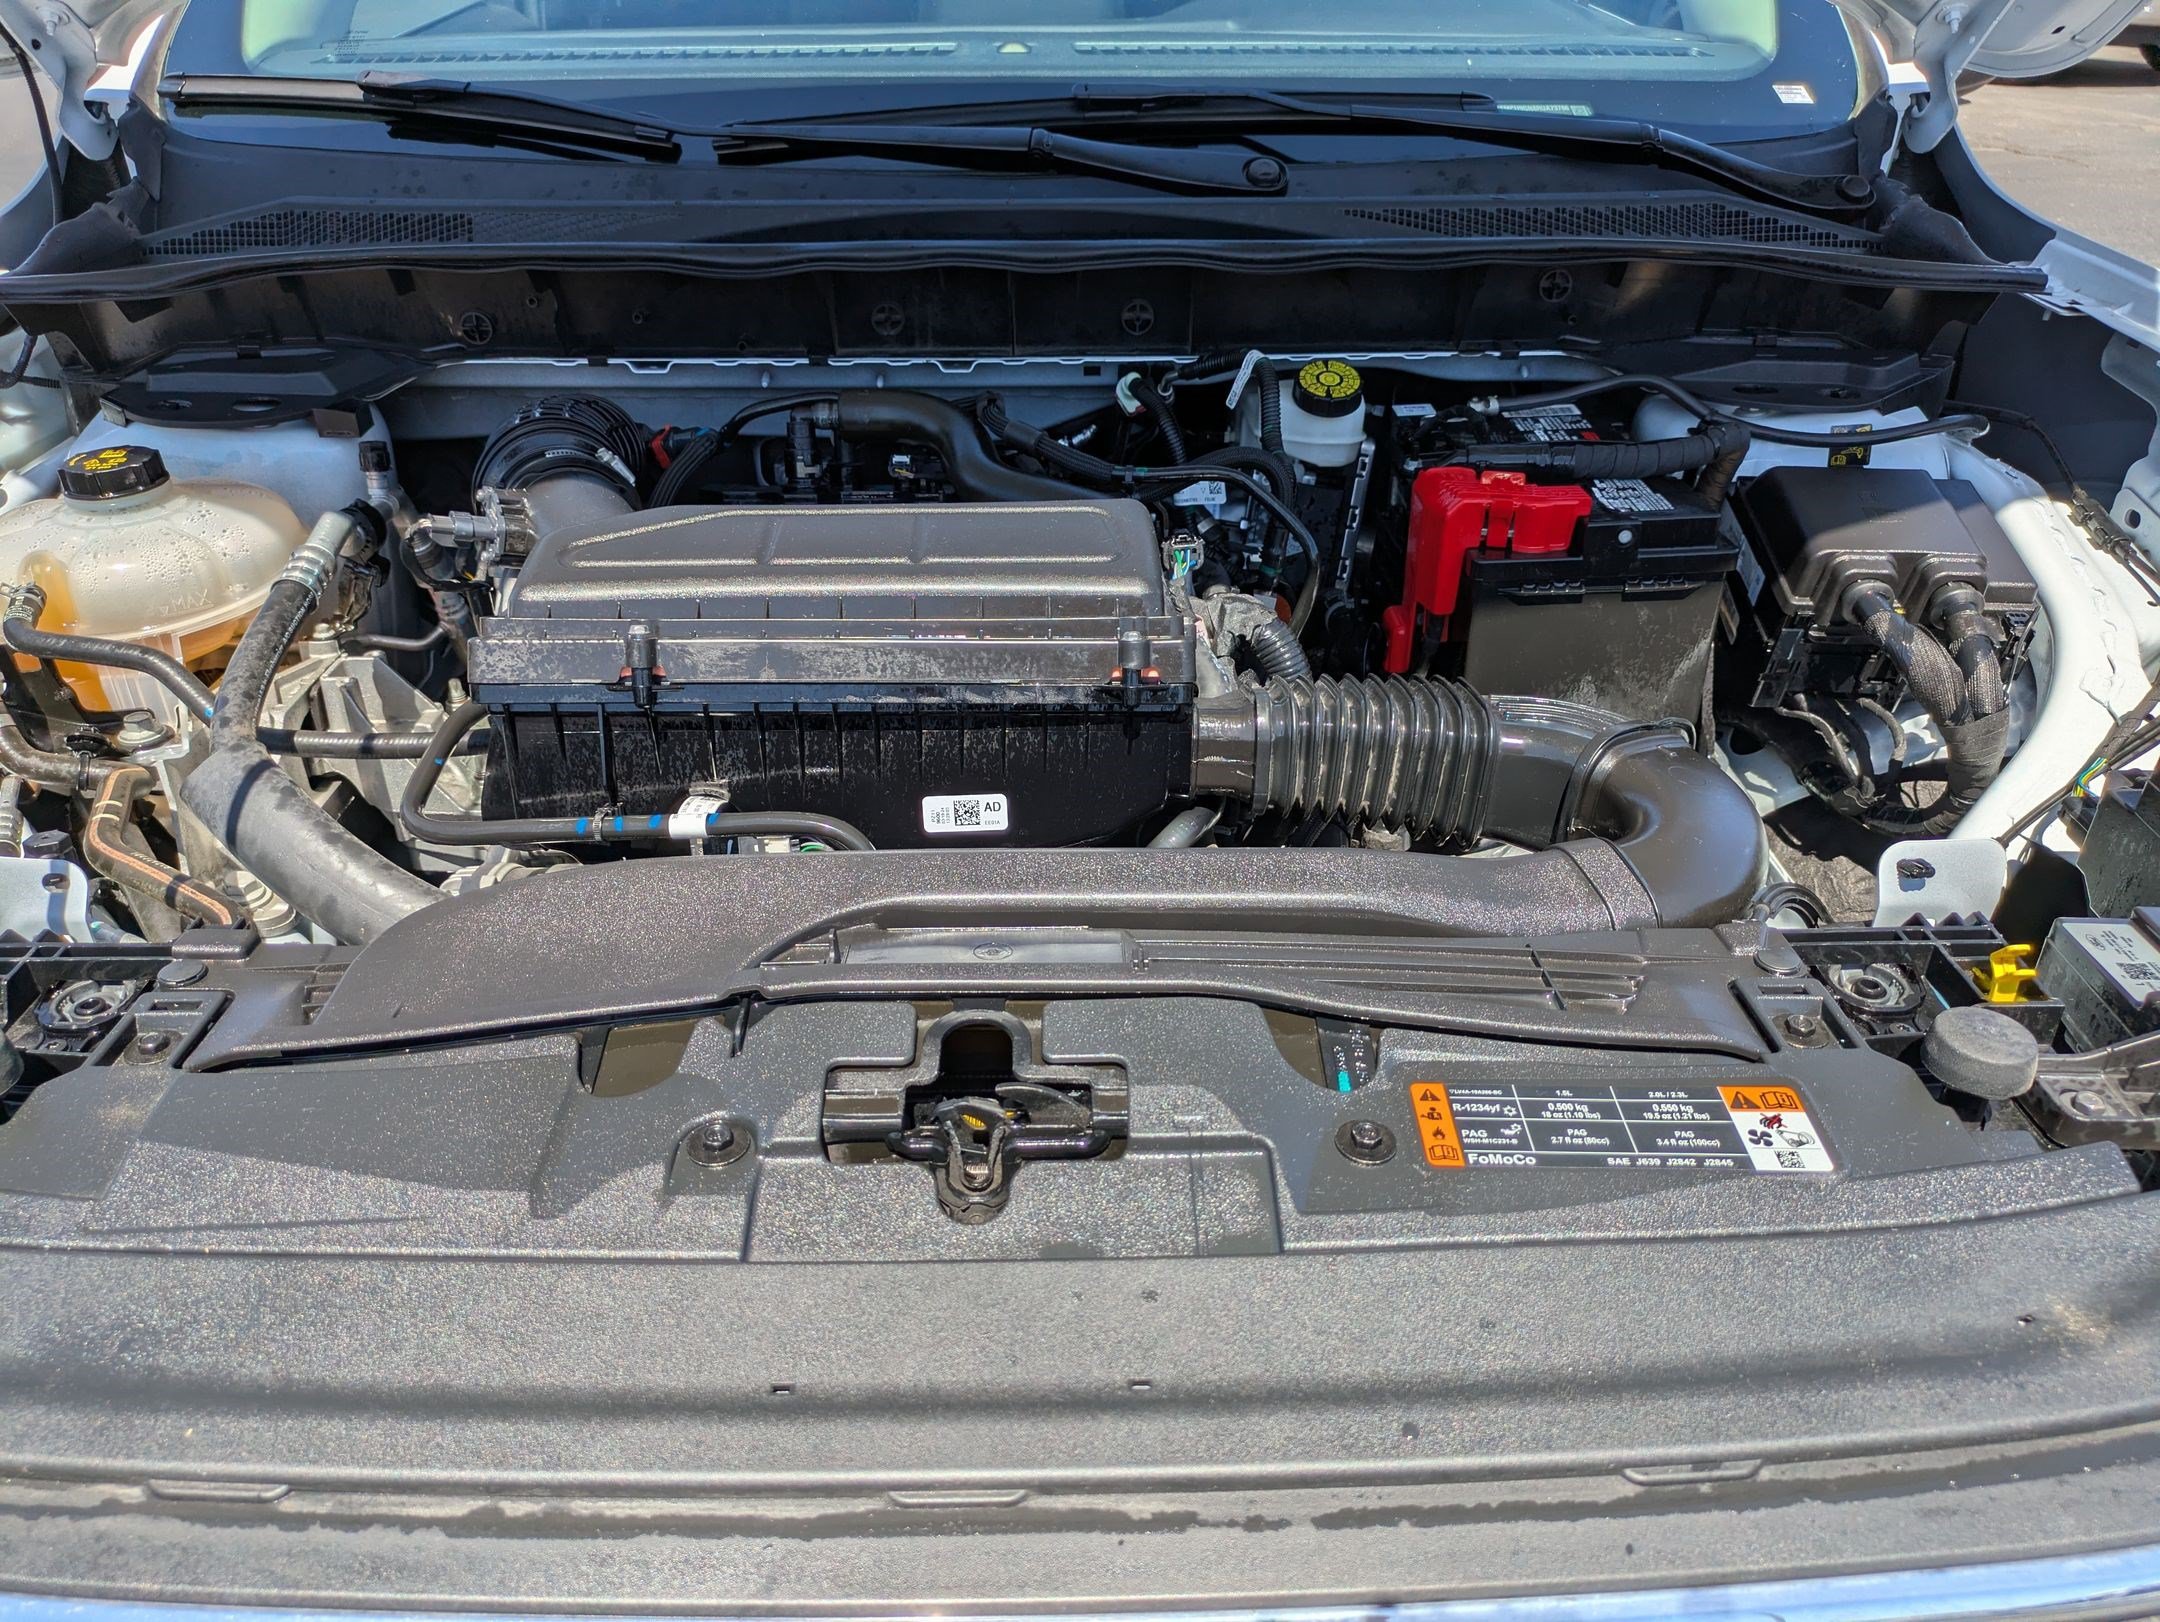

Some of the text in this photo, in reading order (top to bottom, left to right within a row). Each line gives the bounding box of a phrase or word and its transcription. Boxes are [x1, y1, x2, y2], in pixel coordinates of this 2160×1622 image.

[984, 801, 1002, 812] AD
[1547, 1102, 1589, 1113] 0.500 kg
[1679, 1103, 1694, 1113] kg
[1461, 1129, 1488, 1138] PAG
[1567, 1128, 1588, 1136] PAG
[1674, 1130, 1695, 1138] PAG
[1551, 1136, 1564, 1145] 2.7
[1468, 1153, 1537, 1165] FoMoCo
[1607, 1157, 1631, 1166] SAE
